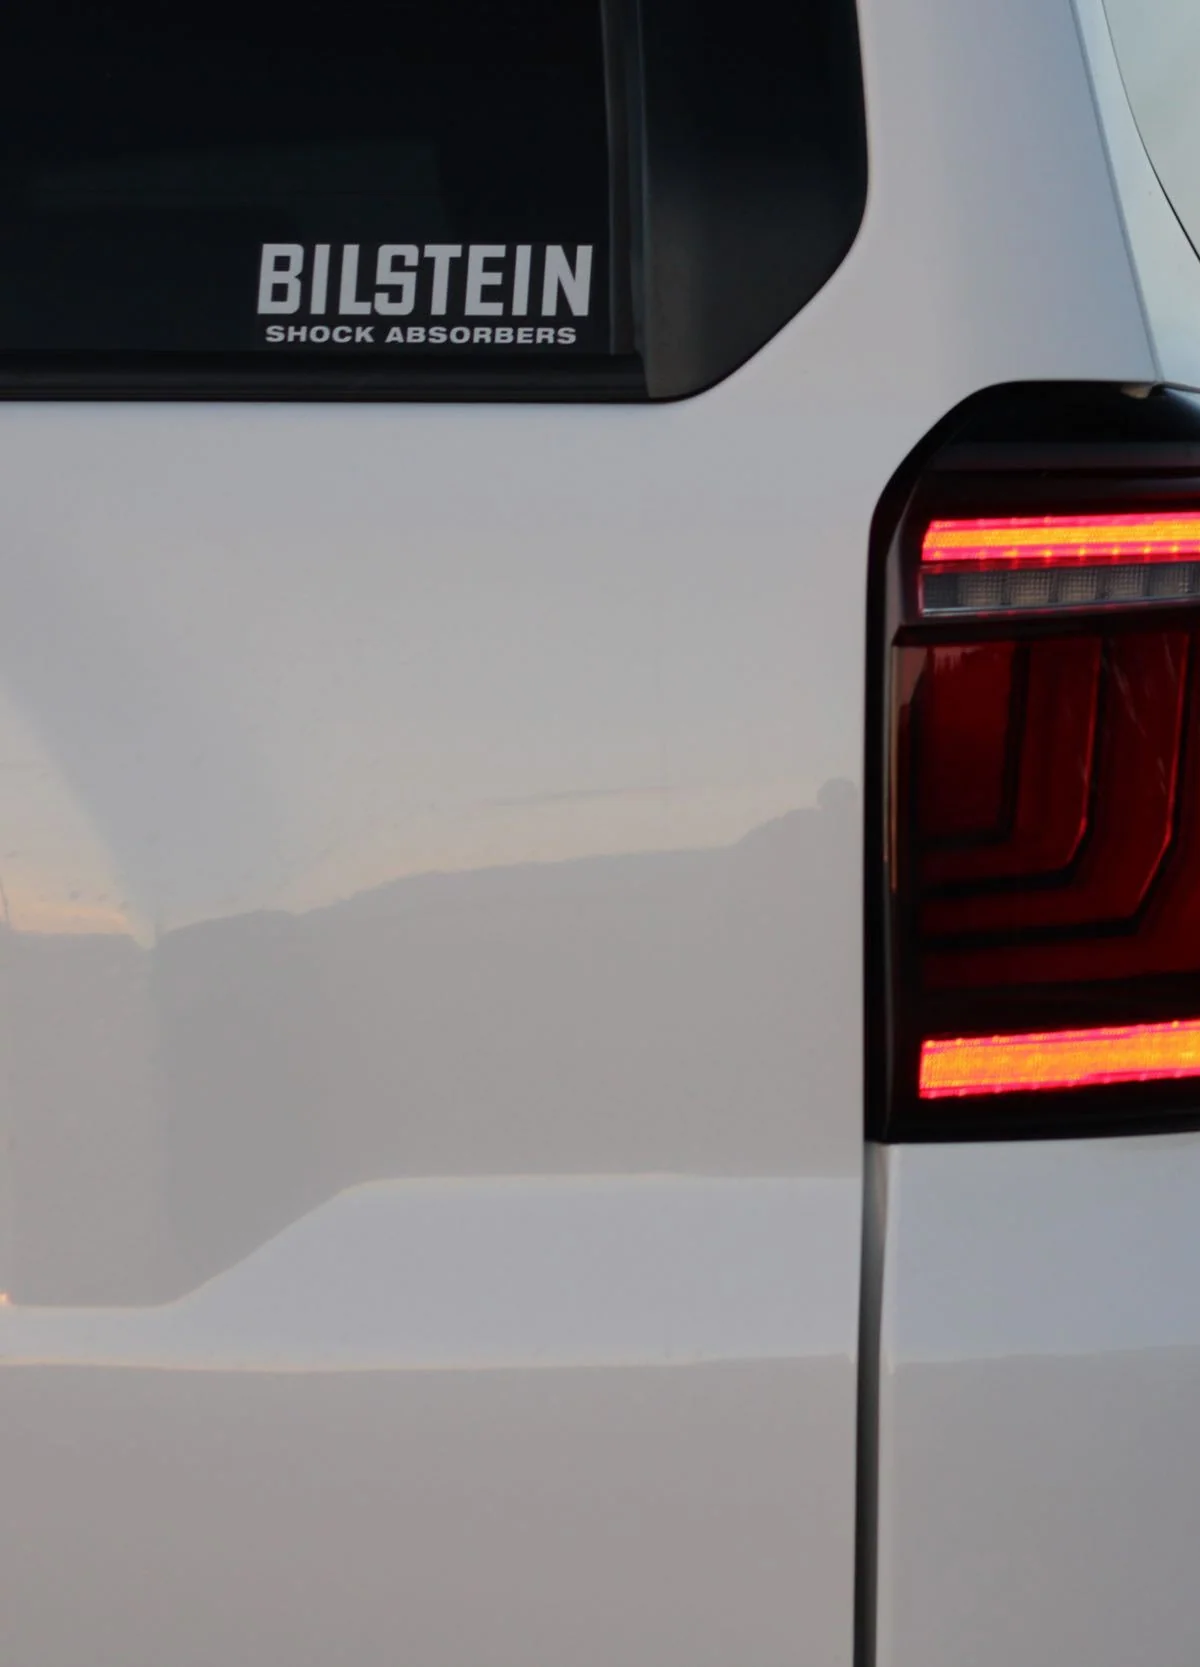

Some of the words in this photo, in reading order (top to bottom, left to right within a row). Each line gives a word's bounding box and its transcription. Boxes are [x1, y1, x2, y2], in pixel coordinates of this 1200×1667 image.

[257, 243, 593, 316] BILSTEIN
[266, 325, 374, 343] SHOCK
[385, 326, 577, 344] ABSORBERS
